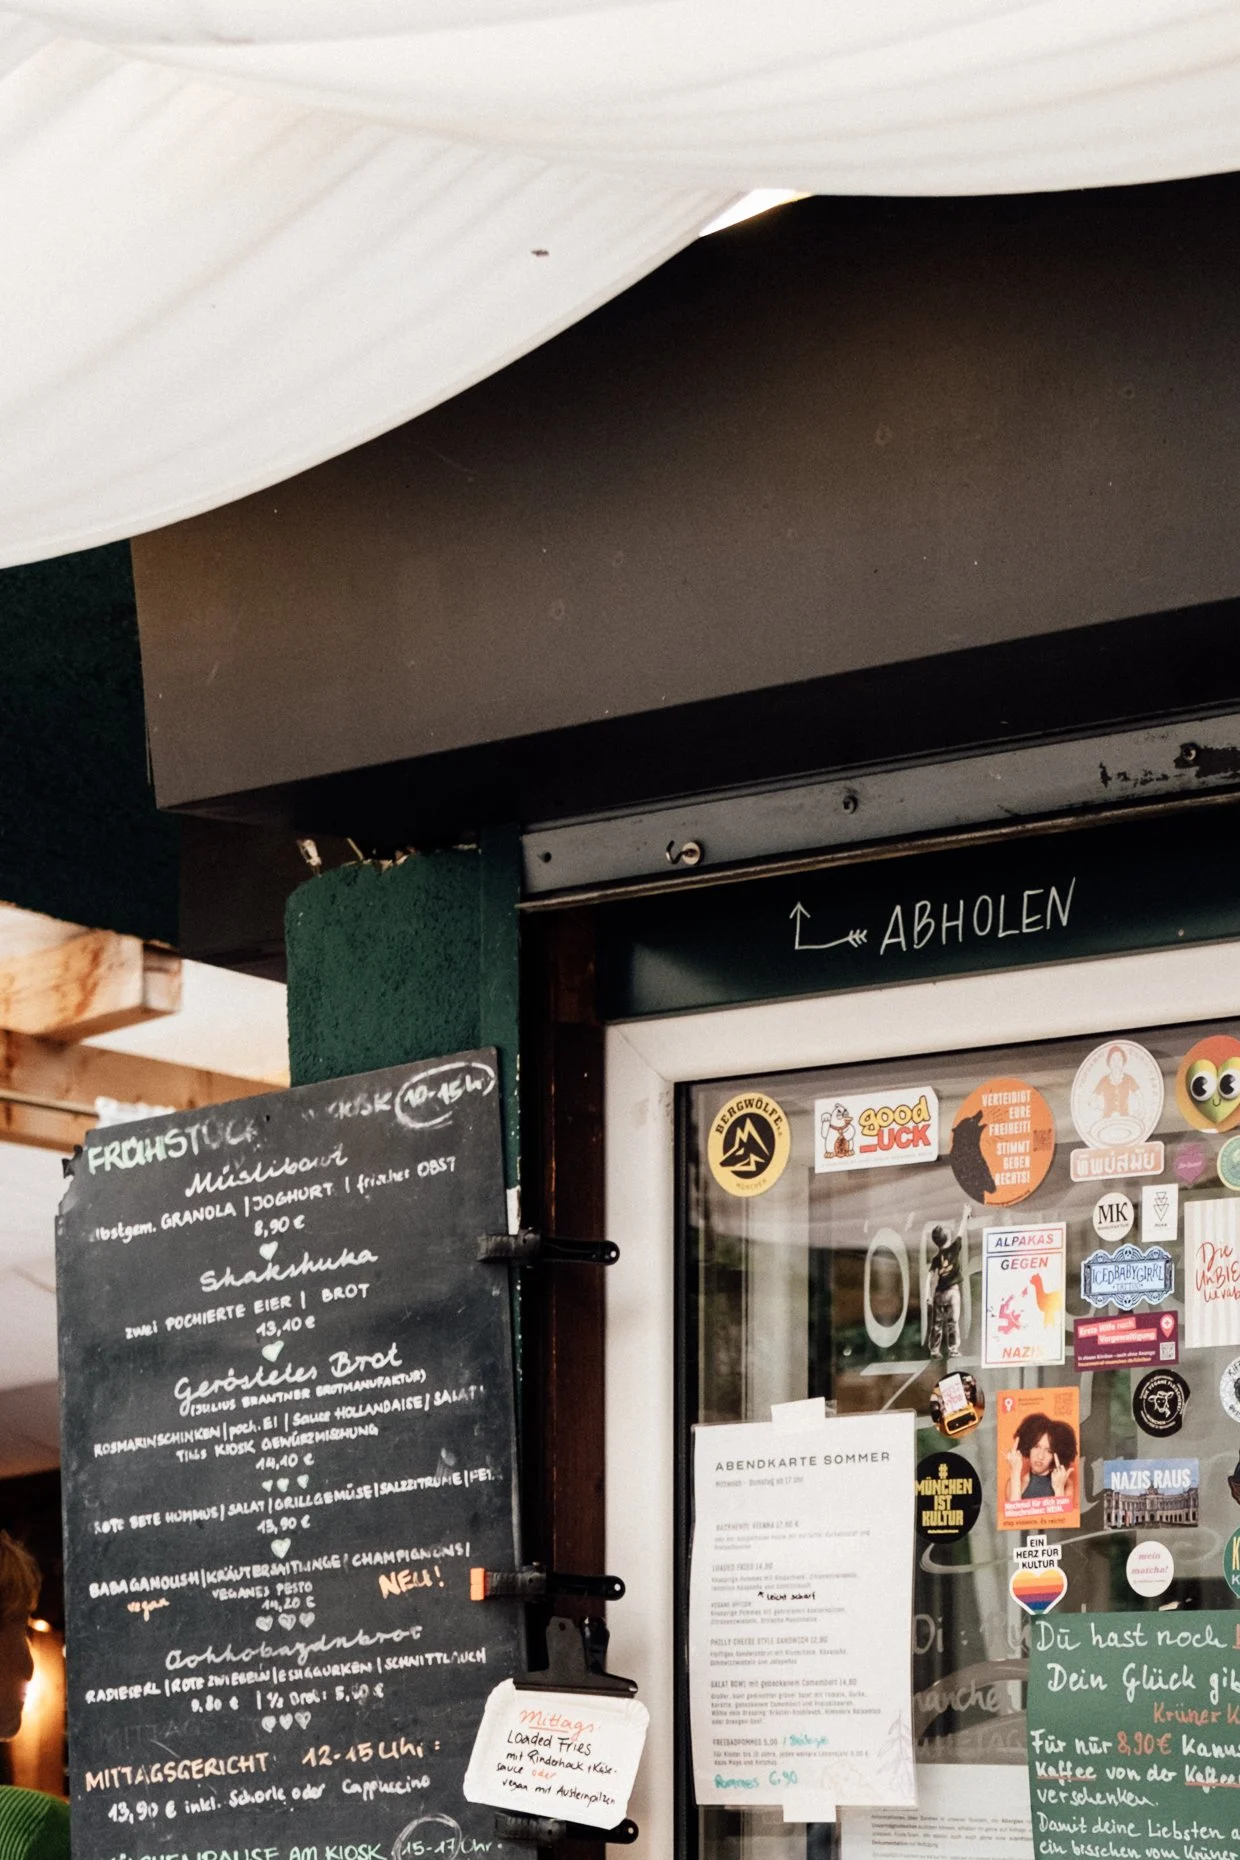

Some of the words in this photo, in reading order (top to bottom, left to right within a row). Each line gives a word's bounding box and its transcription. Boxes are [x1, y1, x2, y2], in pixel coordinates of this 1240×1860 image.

[880, 877, 1076, 955] ABHOLEN
[981, 1089, 1032, 1107] VERTEIDIGT
[715, 1097, 783, 1136] BERGWÖLFE
[859, 1094, 932, 1137] good
[1008, 1105, 1032, 1120] EURE
[996, 1140, 1031, 1156] STIMMT
[161, 1202, 236, 1229] GRANOLA
[252, 1182, 333, 1212] JOGHURT
[416, 1156, 456, 1178] OBST
[1098, 1202, 1129, 1224] MK
[254, 1216, 290, 1239] 8,90
[995, 1233, 1054, 1249] ALPAKAS
[1000, 1257, 1049, 1271] GEGEN
[1196, 1241, 1233, 1272] Die
[199, 1248, 378, 1292] Shakshuka
[124, 1320, 158, 1340] zwei
[165, 1304, 246, 1331] POCHIERTE
[253, 1295, 292, 1315] EIER
[321, 1283, 370, 1303] BROT
[256, 1316, 302, 1338] 13,10
[173, 1362, 318, 1418] Geröstetes
[328, 1342, 402, 1379] Brot
[292, 1411, 332, 1428] Sauce
[334, 1396, 424, 1421] HOLLANDAISE
[214, 1439, 256, 1458] KIOSK
[715, 1456, 817, 1472] ABENDKARTE
[823, 1452, 891, 1466] SOMMER
[938, 1463, 948, 1479] #
[915, 1476, 973, 1497] MÜNCHEN
[1110, 1470, 1151, 1490] NAZIS
[1153, 1469, 1191, 1489] RAUS
[933, 1495, 953, 1512] IST
[129, 1512, 162, 1529] BETE
[165, 1506, 219, 1524] HUMMUS
[227, 1500, 265, 1517] SALAT
[921, 1509, 965, 1527] KULTUR
[1016, 1550, 1039, 1559] HERZ
[1041, 1548, 1060, 1558] FÜR
[1030, 1538, 1045, 1548] EIN
[1022, 1560, 1056, 1569] KULTUR
[1138, 1551, 1161, 1561] mein
[1131, 1563, 1170, 1576] matcha!
[275, 1580, 313, 1596] PESTO
[790, 1592, 816, 1600] scharf
[1090, 1621, 1149, 1649] hast
[1156, 1624, 1228, 1649] noch
[1046, 1662, 1109, 1693] Dein
[1121, 1661, 1197, 1704] Glück
[1153, 1701, 1222, 1727] Krüner
[519, 1709, 596, 1742] Mittags
[506, 1729, 552, 1748] Loaded
[557, 1737, 593, 1757] Fries
[1029, 1727, 1067, 1756] Für
[506, 1752, 523, 1762] mit
[85, 1752, 269, 1793] MITTAGSGERICHT
[302, 1744, 374, 1768] 12-15
[496, 1762, 524, 1776] sauce
[531, 1768, 559, 1781] oder
[1035, 1760, 1097, 1787] Kaffee
[1105, 1767, 1141, 1782] von
[1146, 1763, 1178, 1783] der
[502, 1778, 529, 1793] vegan
[534, 1784, 552, 1796] mit
[1036, 1786, 1159, 1807] verschenken.
[107, 1800, 159, 1825] 13,90
[228, 1785, 287, 1808] Schorle
[291, 1783, 326, 1800] oder
[341, 1774, 432, 1802] Cappuccino
[1036, 1810, 1088, 1834] Damit
[1091, 1815, 1142, 1837] deine
[1147, 1817, 1226, 1842] Liebsten
[1039, 1839, 1068, 1854] ein
[1071, 1839, 1143, 1860] bisschen
[1145, 1846, 1181, 1860] vom
